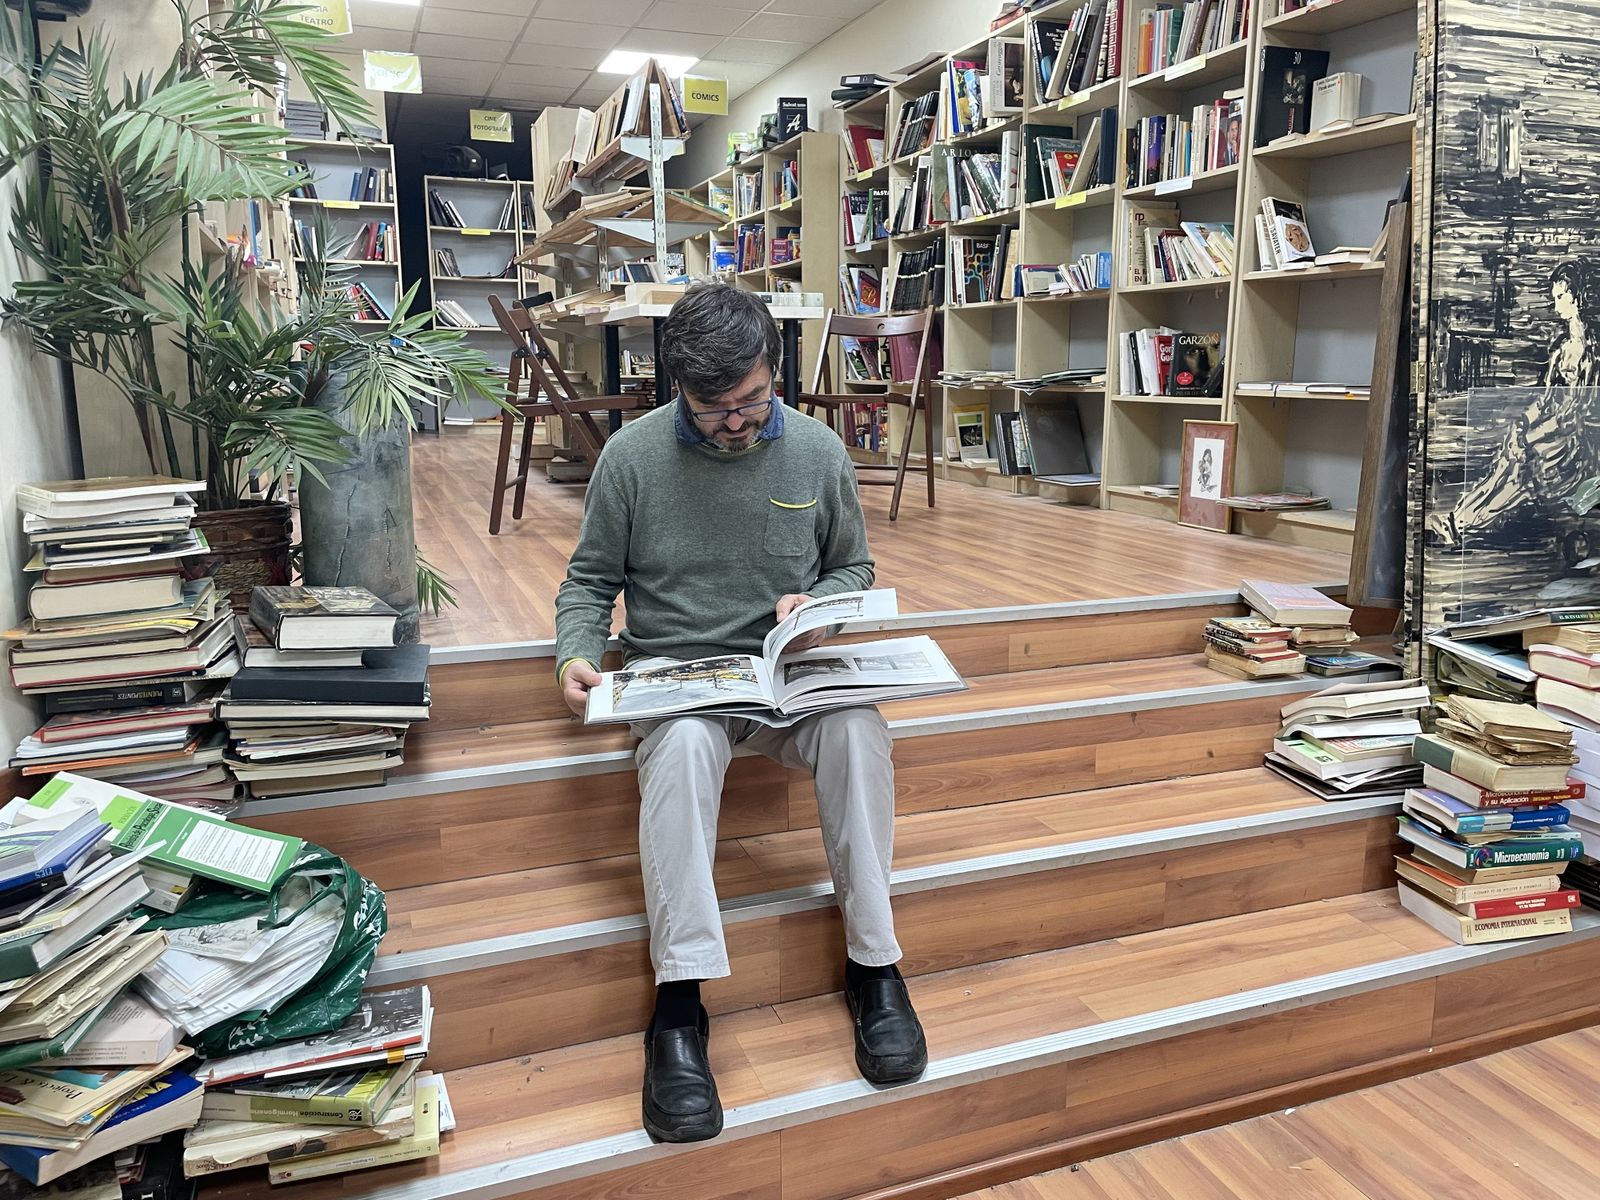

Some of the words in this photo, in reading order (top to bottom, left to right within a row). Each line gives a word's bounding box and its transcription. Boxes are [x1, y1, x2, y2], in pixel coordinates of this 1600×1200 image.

[300, 14, 334, 26] TEATRO
[691, 92, 720, 102] COMICS
[1499, 796, 1529, 805] Aplicación
[1494, 848, 1550, 864] Microeconomía
